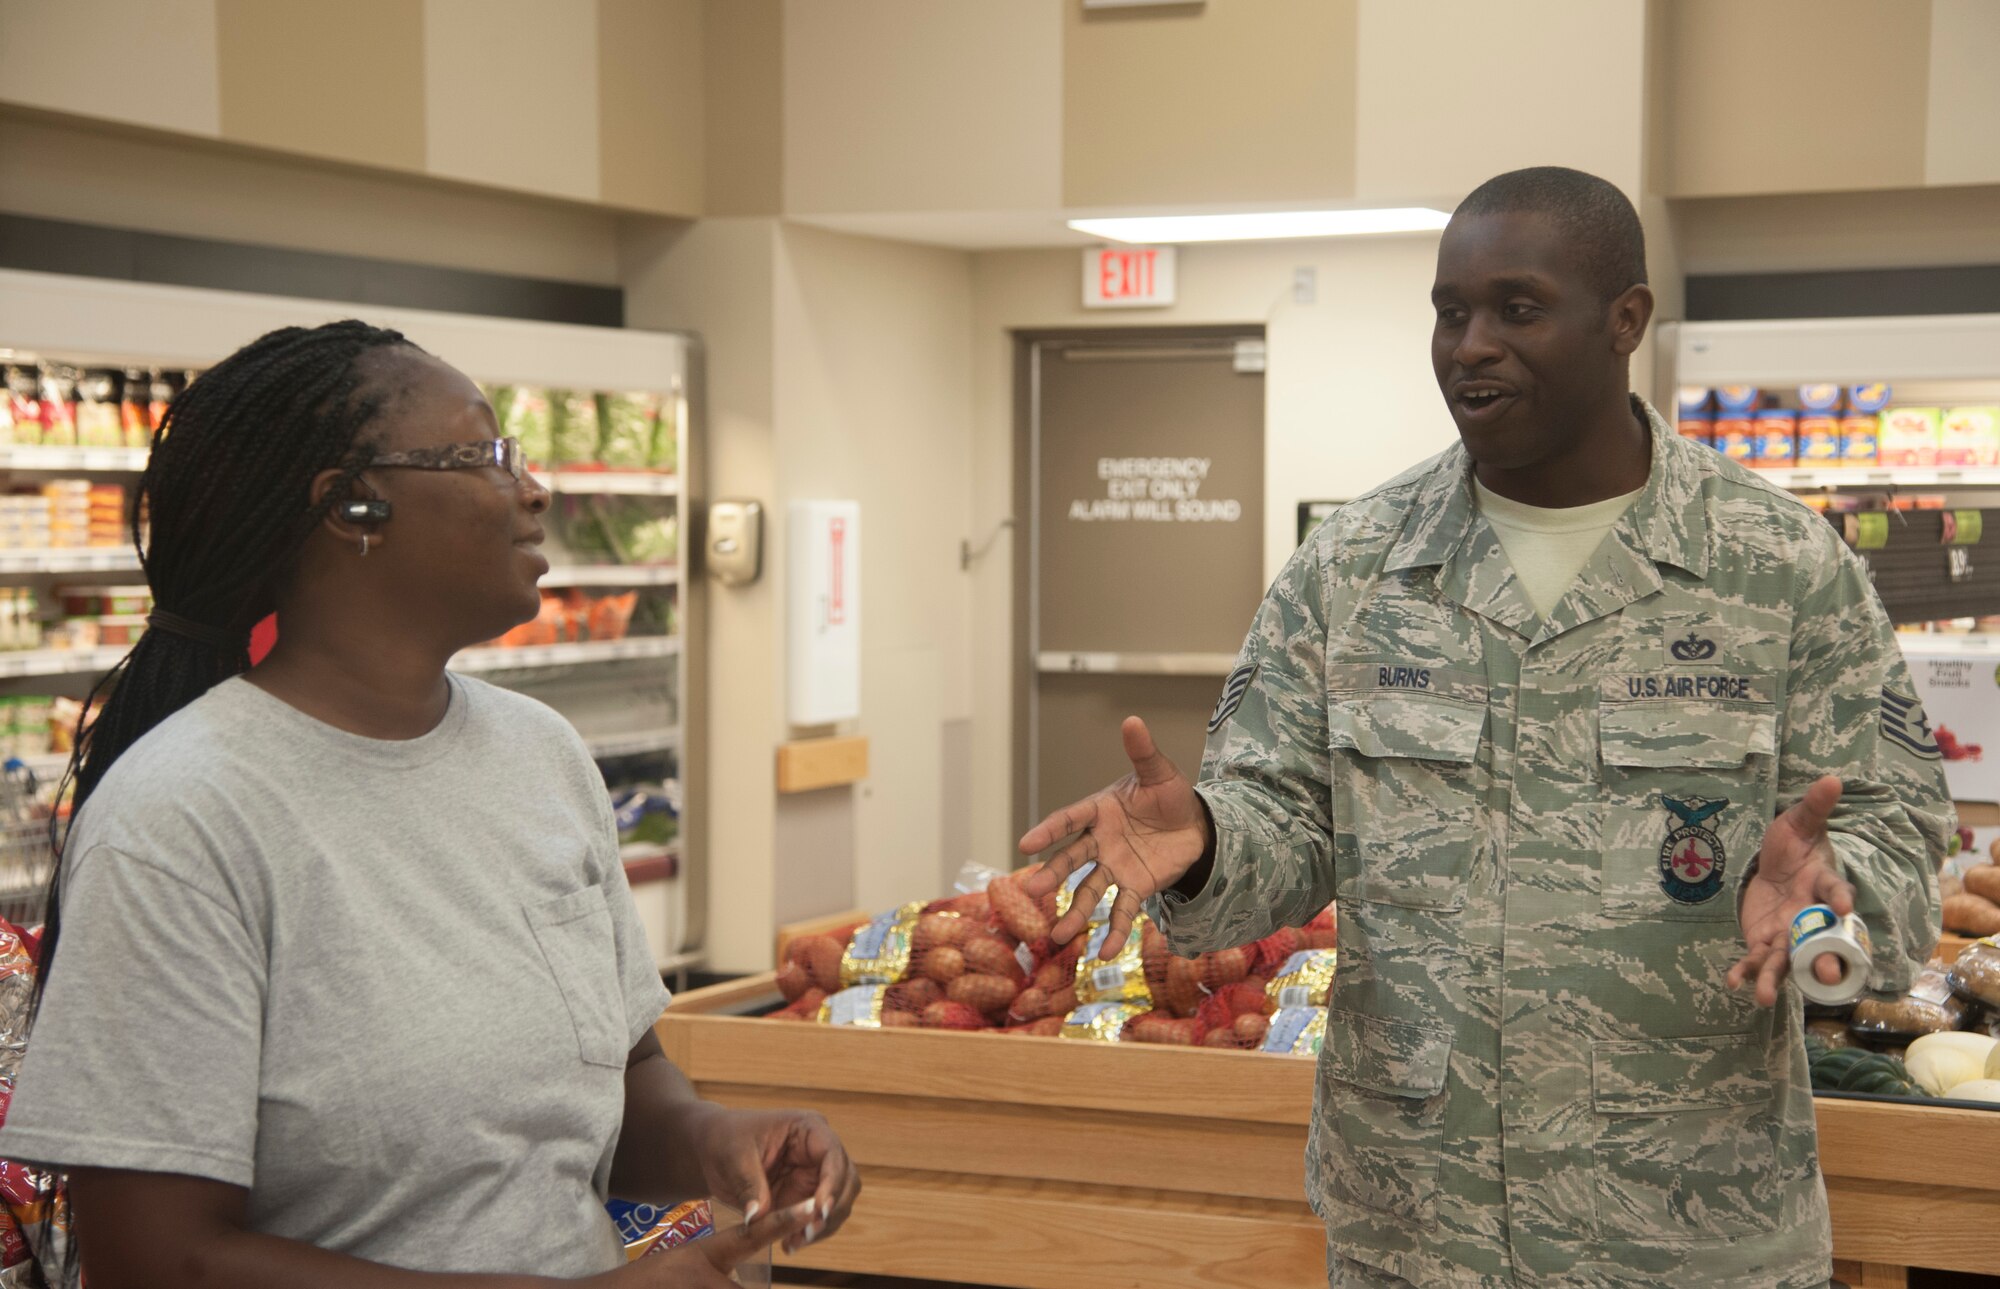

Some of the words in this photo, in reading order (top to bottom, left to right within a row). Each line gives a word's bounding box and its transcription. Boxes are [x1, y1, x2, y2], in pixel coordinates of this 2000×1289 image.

[1099, 250, 1158, 299] EXIT
[1098, 458, 1211, 479] EMERGENCY
[1108, 479, 1148, 499] EXIT
[1149, 479, 1199, 499] ONLY
[1068, 500, 1131, 521] ALARM
[1132, 500, 1174, 521] WILL
[1174, 500, 1241, 521] SOUND
[1928, 660, 1973, 670] Healthy
[1936, 670, 1962, 678] Fruit
[1379, 666, 1430, 688] BURNS
[1629, 677, 1661, 698] U.S.
[1664, 677, 1693, 697] AIR
[1696, 676, 1749, 698] FORCE
[1928, 679, 1971, 688] Snacks
[1662, 841, 1676, 871] FIRE
[1674, 826, 1725, 871] PROTECTION
